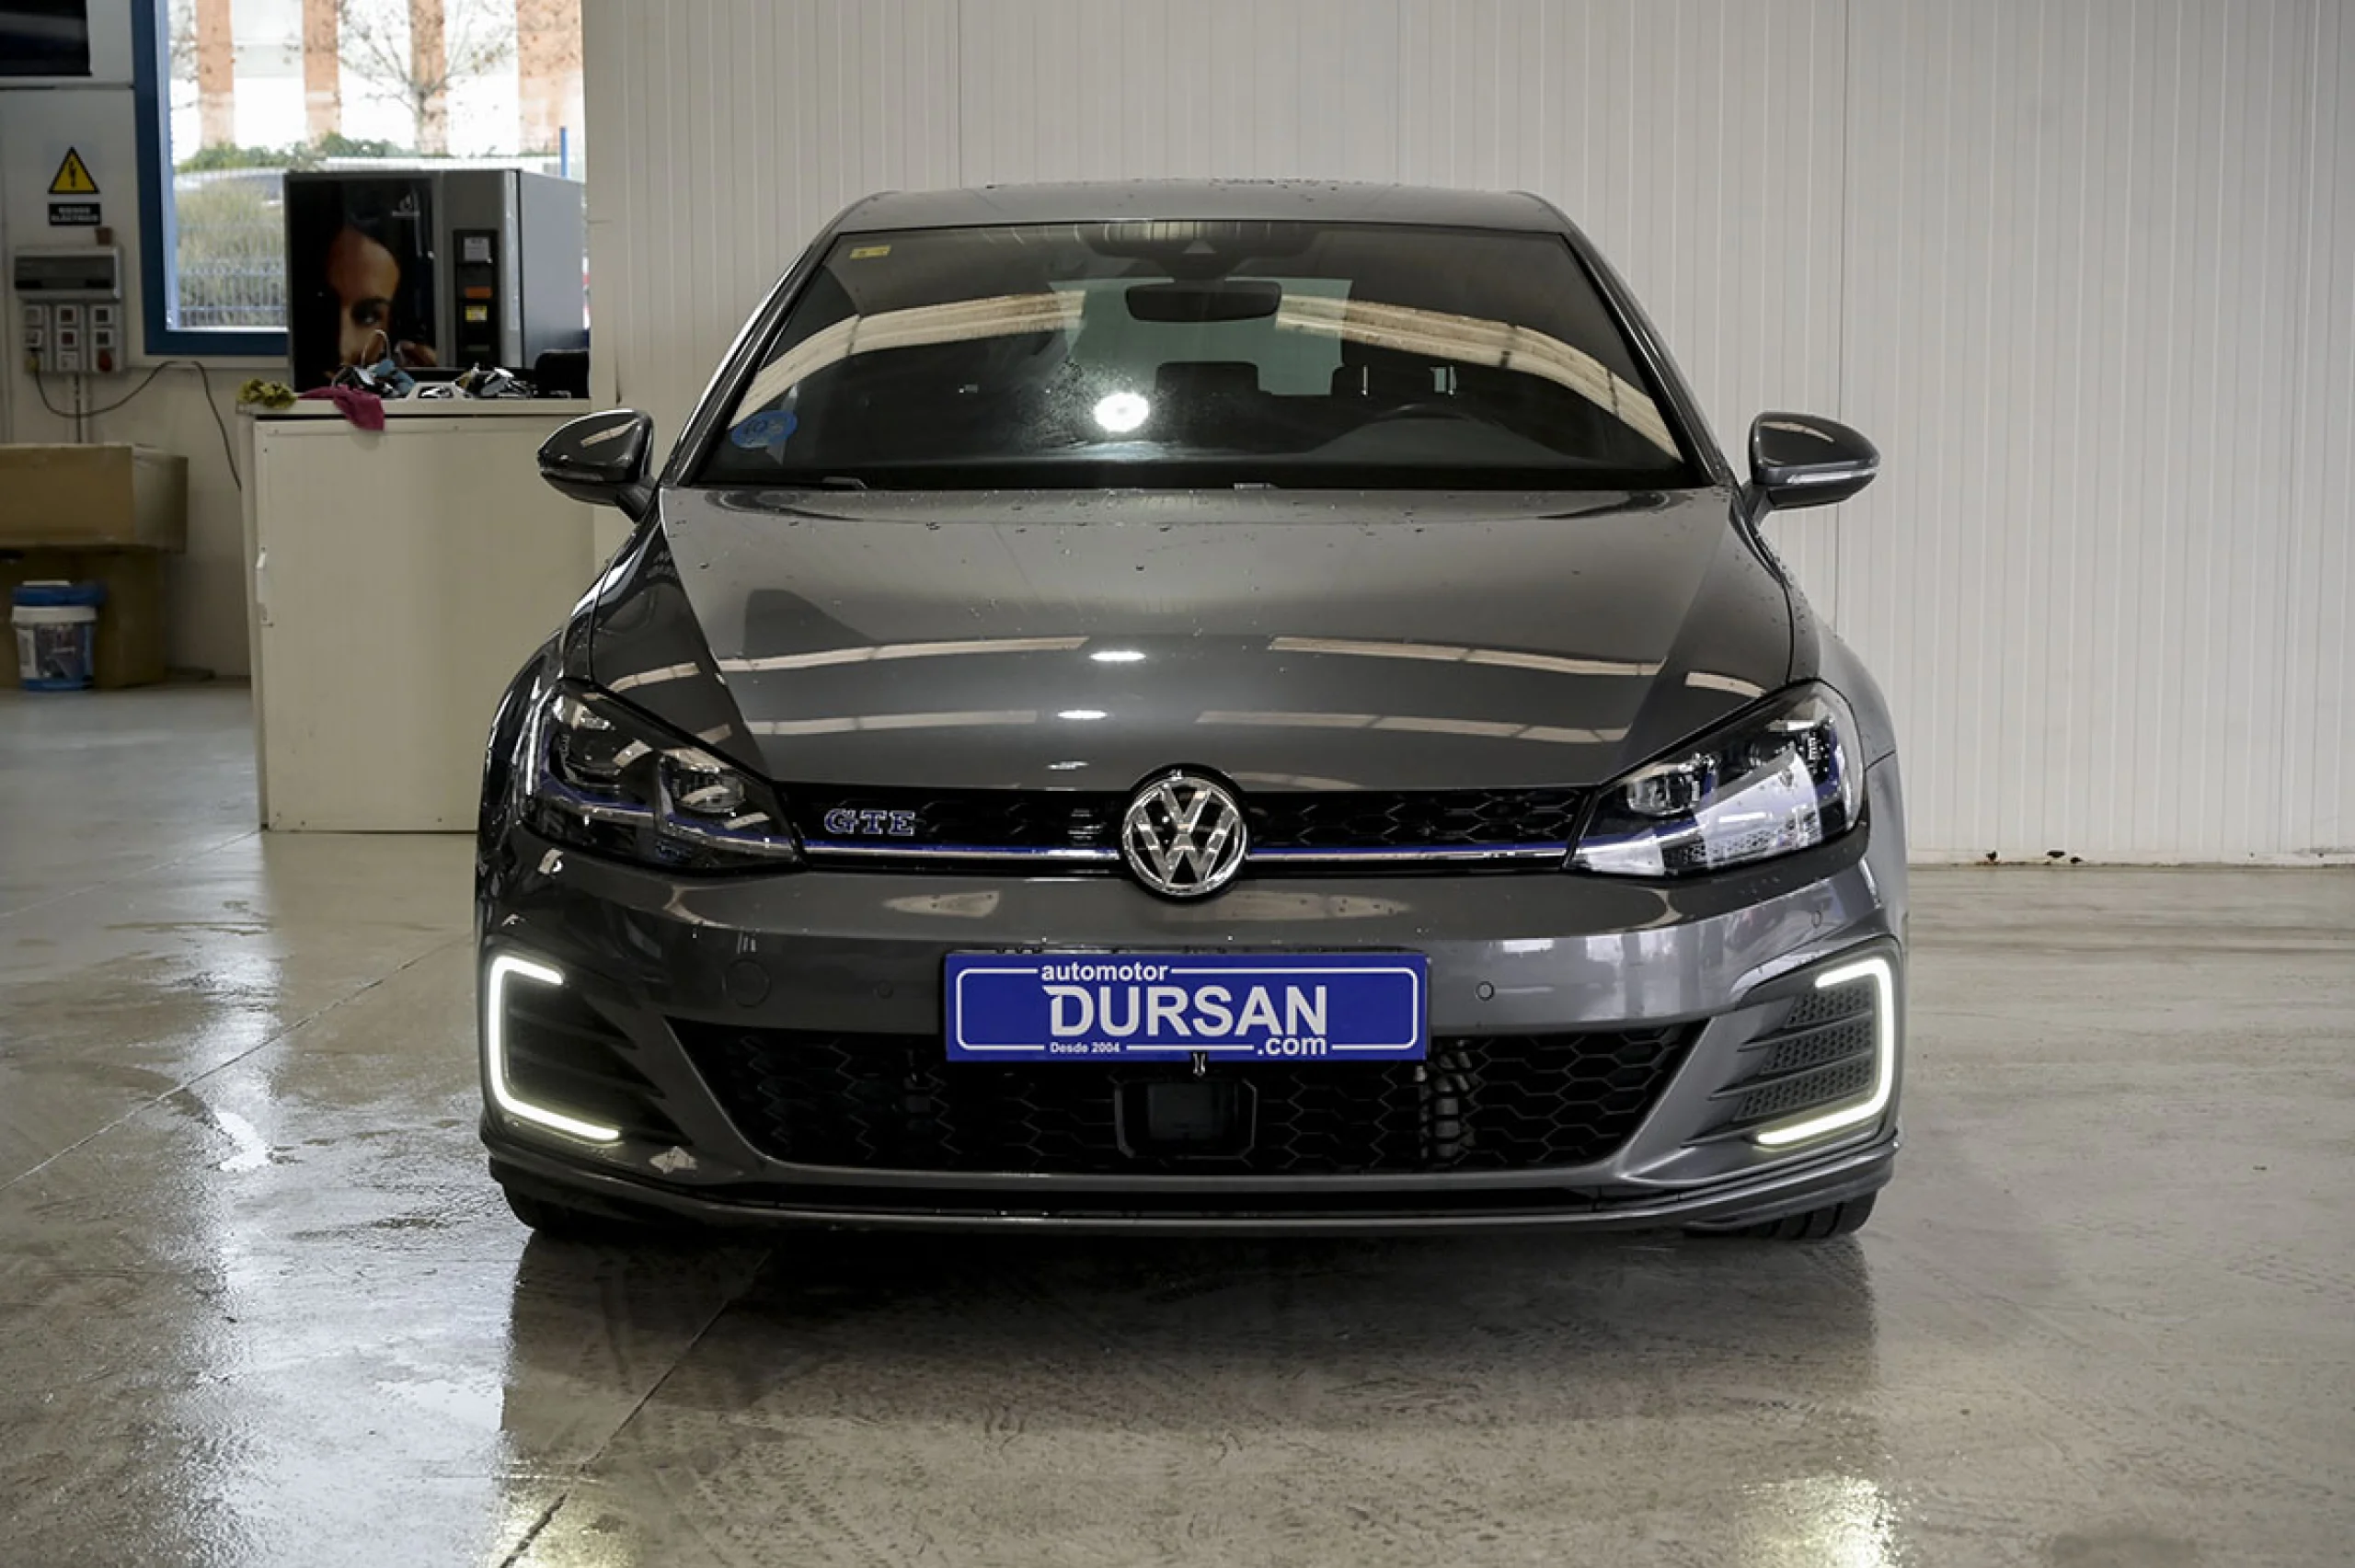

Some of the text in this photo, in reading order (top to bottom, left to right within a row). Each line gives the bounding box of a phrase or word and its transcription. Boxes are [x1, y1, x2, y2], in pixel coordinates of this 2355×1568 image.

[824, 808, 915, 836] GTE
[1041, 961, 1169, 982] automotor
[1042, 985, 1327, 1036] DURSAN
[1050, 1042, 1120, 1053] Desde 2004
[1258, 1036, 1327, 1057] .com
